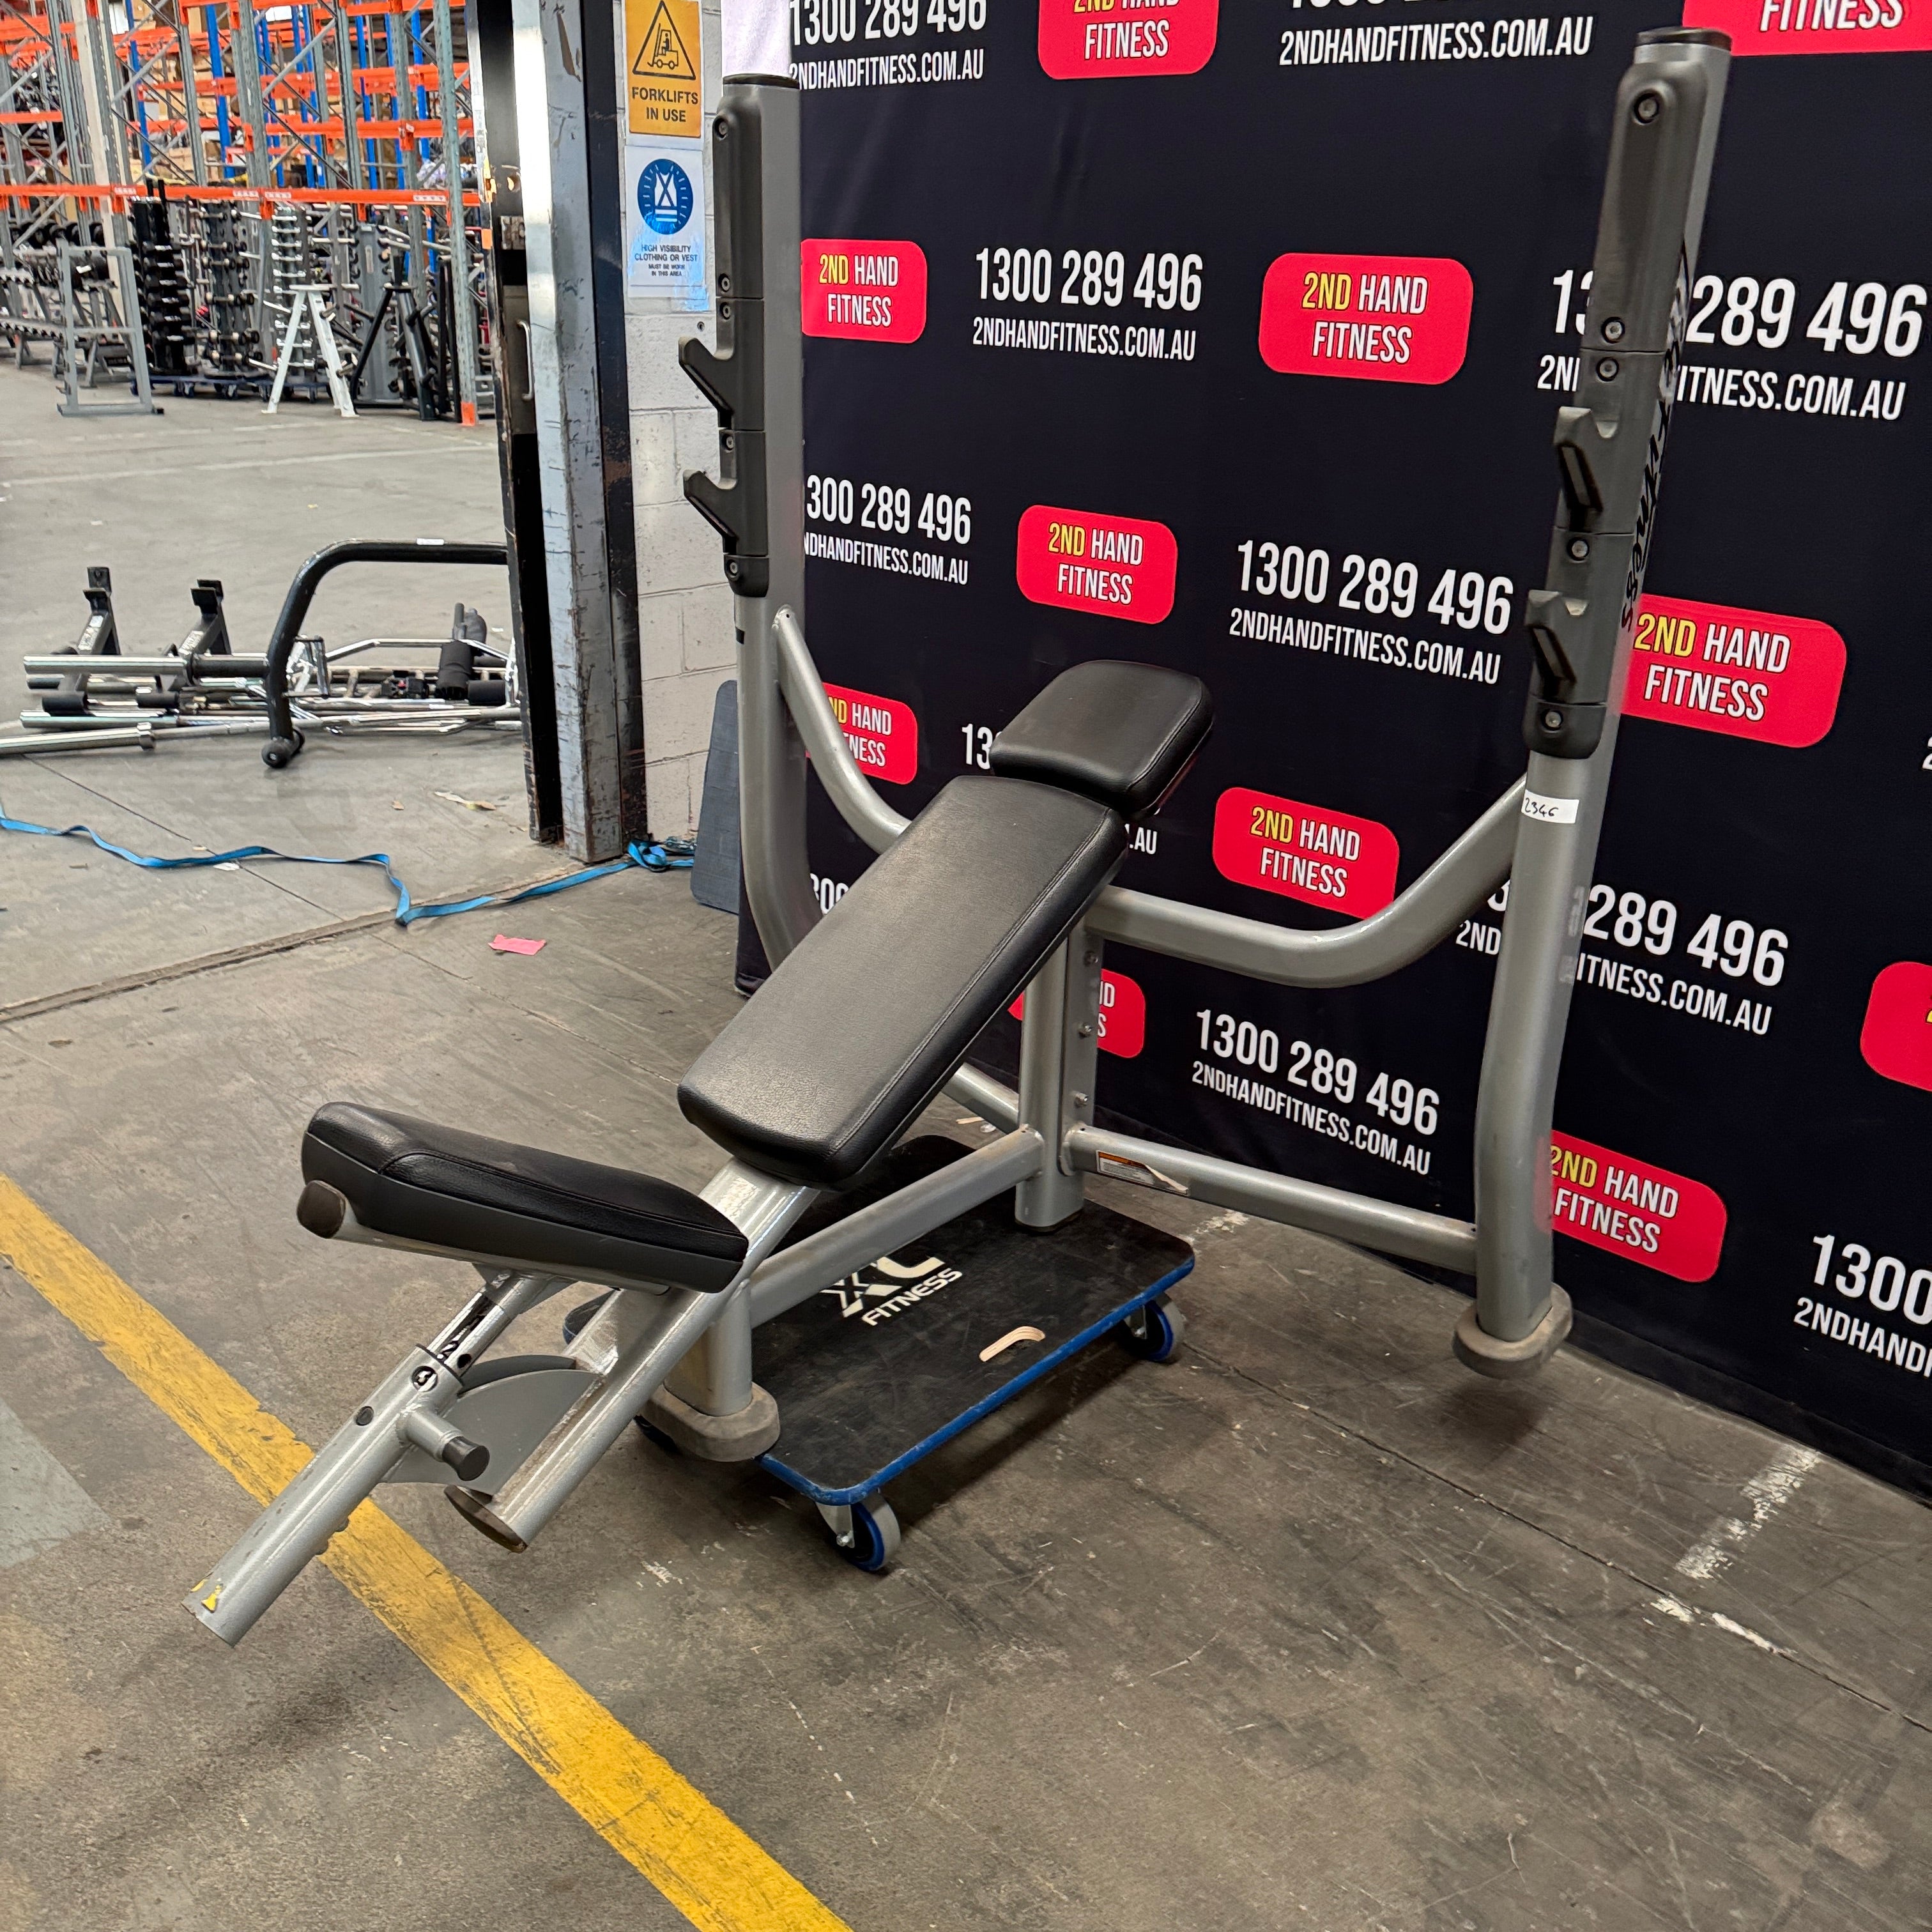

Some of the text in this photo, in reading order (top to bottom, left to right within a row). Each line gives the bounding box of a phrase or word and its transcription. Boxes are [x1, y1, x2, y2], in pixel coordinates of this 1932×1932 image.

[790, 0, 987, 45] 1300 289 496
[1085, 20, 1169, 59] FITNESS
[1279, 17, 1593, 65] 2NDHANDFITNESS.COM.AU
[1759, 0, 1904, 32] FITNESS
[632, 87, 698, 104] FORKLIFTS
[647, 107, 686, 122] IN USE
[634, 253, 667, 261] CLOTHING
[818, 254, 899, 286] 2ND HAND
[976, 247, 1203, 311] 1300 289 496
[827, 293, 892, 327] FITNESS
[1302, 272, 1429, 314] 2ND HAND
[1685, 275, 1928, 358] 289 496
[973, 316, 1196, 361] 2NDHANDFITNESS.COM.AU
[1312, 321, 1412, 364] FITNESS
[806, 475, 971, 544] 300 289 496
[804, 532, 969, 585] NDHANDFITNESS.COM.AU
[1048, 523, 1143, 565] 2ND HAND
[1057, 564, 1133, 604] FITNESS
[1238, 540, 1514, 634] 1300 289 496
[1229, 607, 1501, 685] 2NDHANDFITNESS.COM.AU
[1634, 613, 1790, 673] 2ND HAND
[1644, 664, 1768, 721] FITNESS
[852, 702, 892, 736] HAND
[1525, 797, 1559, 817] 2346
[1250, 806, 1361, 861] 2ND HAND
[1260, 847, 1348, 898] FITNESS
[1584, 884, 1677, 956] 289
[1687, 914, 1789, 986] 496
[1197, 1009, 1440, 1135] 1300 289 496
[1192, 1061, 1432, 1176] 2NDHANDFITNESS.COM.AU
[1551, 1145, 1680, 1219] 2ND HAND
[1554, 1187, 1661, 1253] FITNESS
[861, 1268, 963, 1327] FITNESS
[1813, 1234, 1932, 1326] 1300
